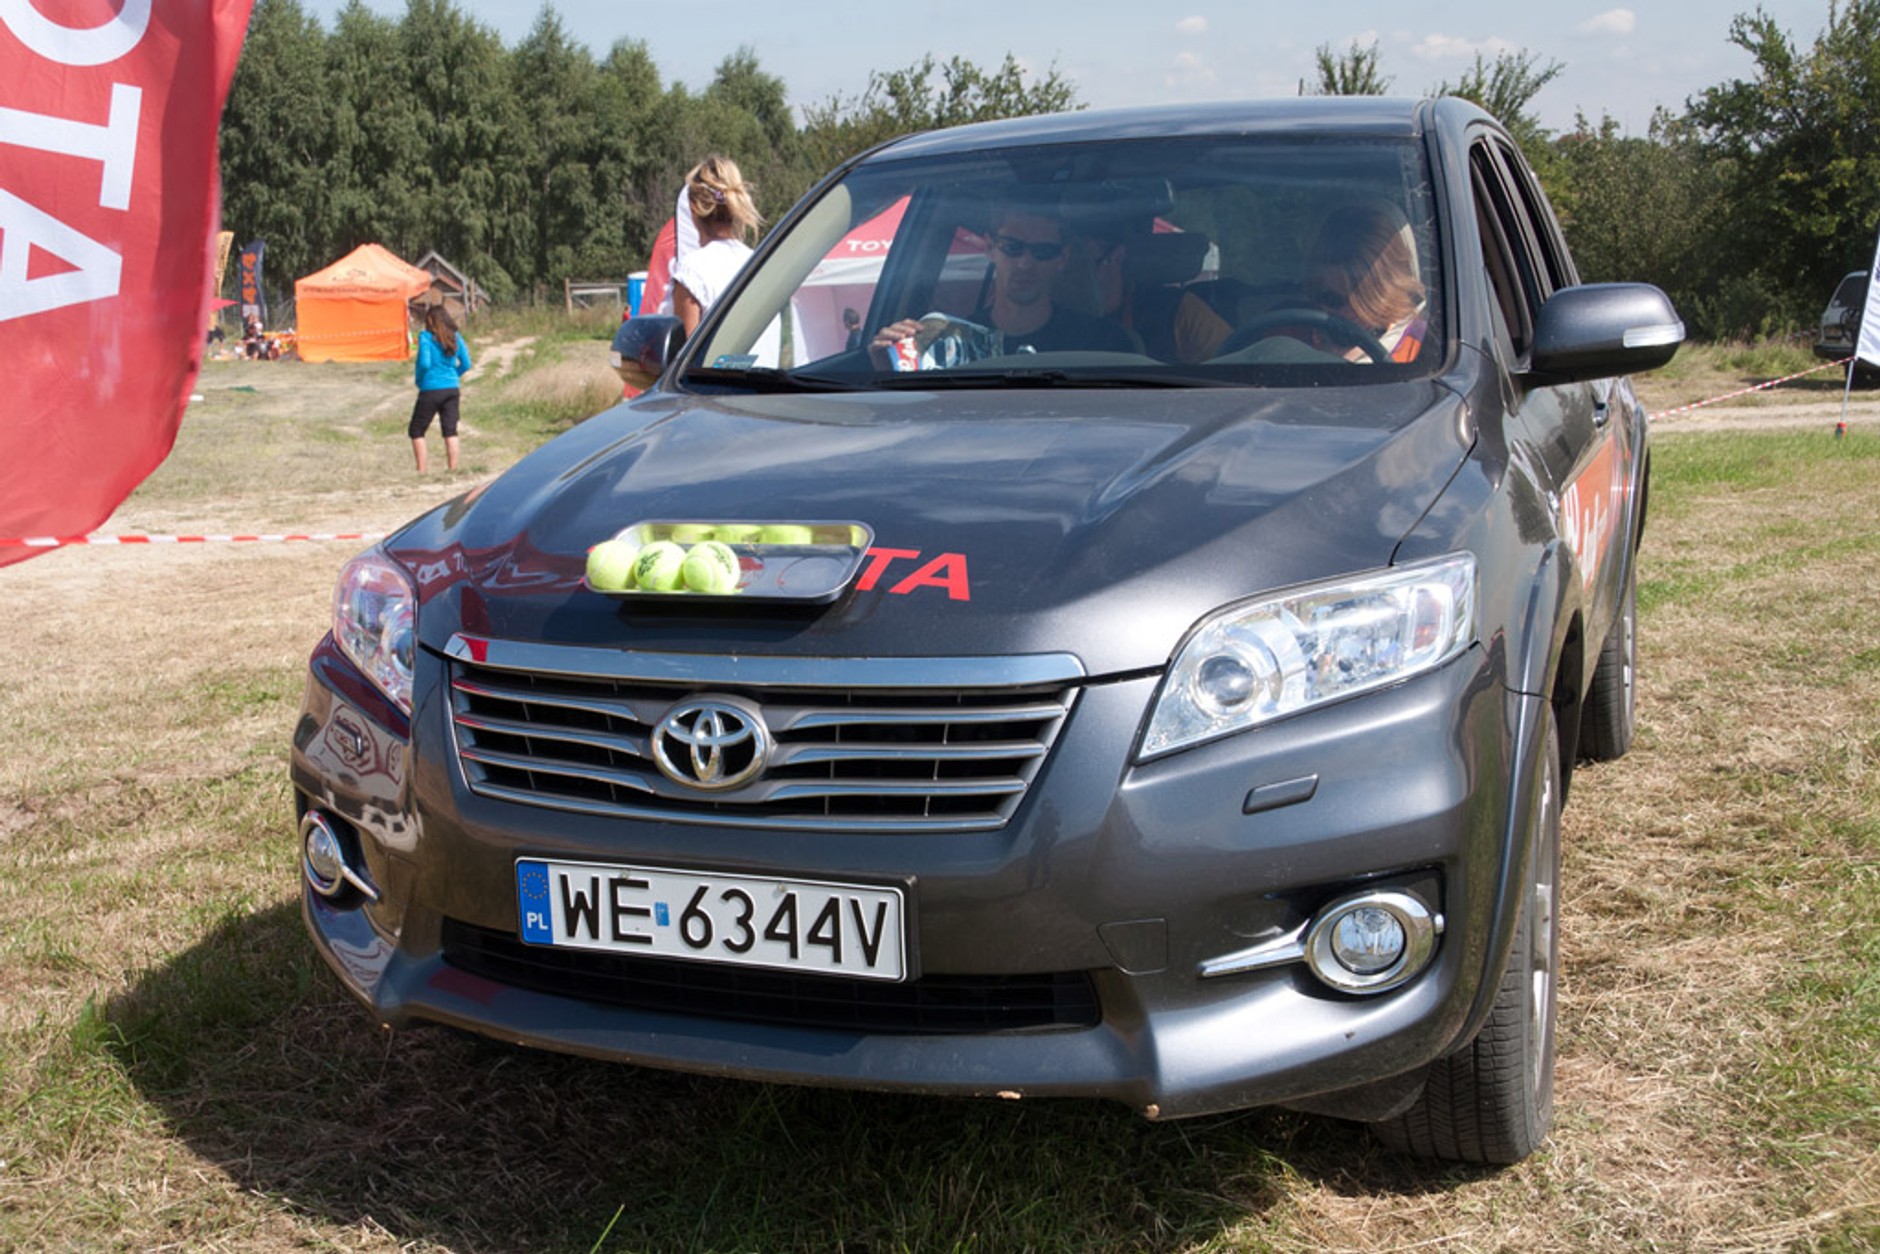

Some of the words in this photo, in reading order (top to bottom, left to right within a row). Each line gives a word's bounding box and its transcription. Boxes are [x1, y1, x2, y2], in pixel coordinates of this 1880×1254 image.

[526, 911, 549, 931] PL
[560, 873, 653, 945] WE
[679, 885, 889, 968] 6344V
